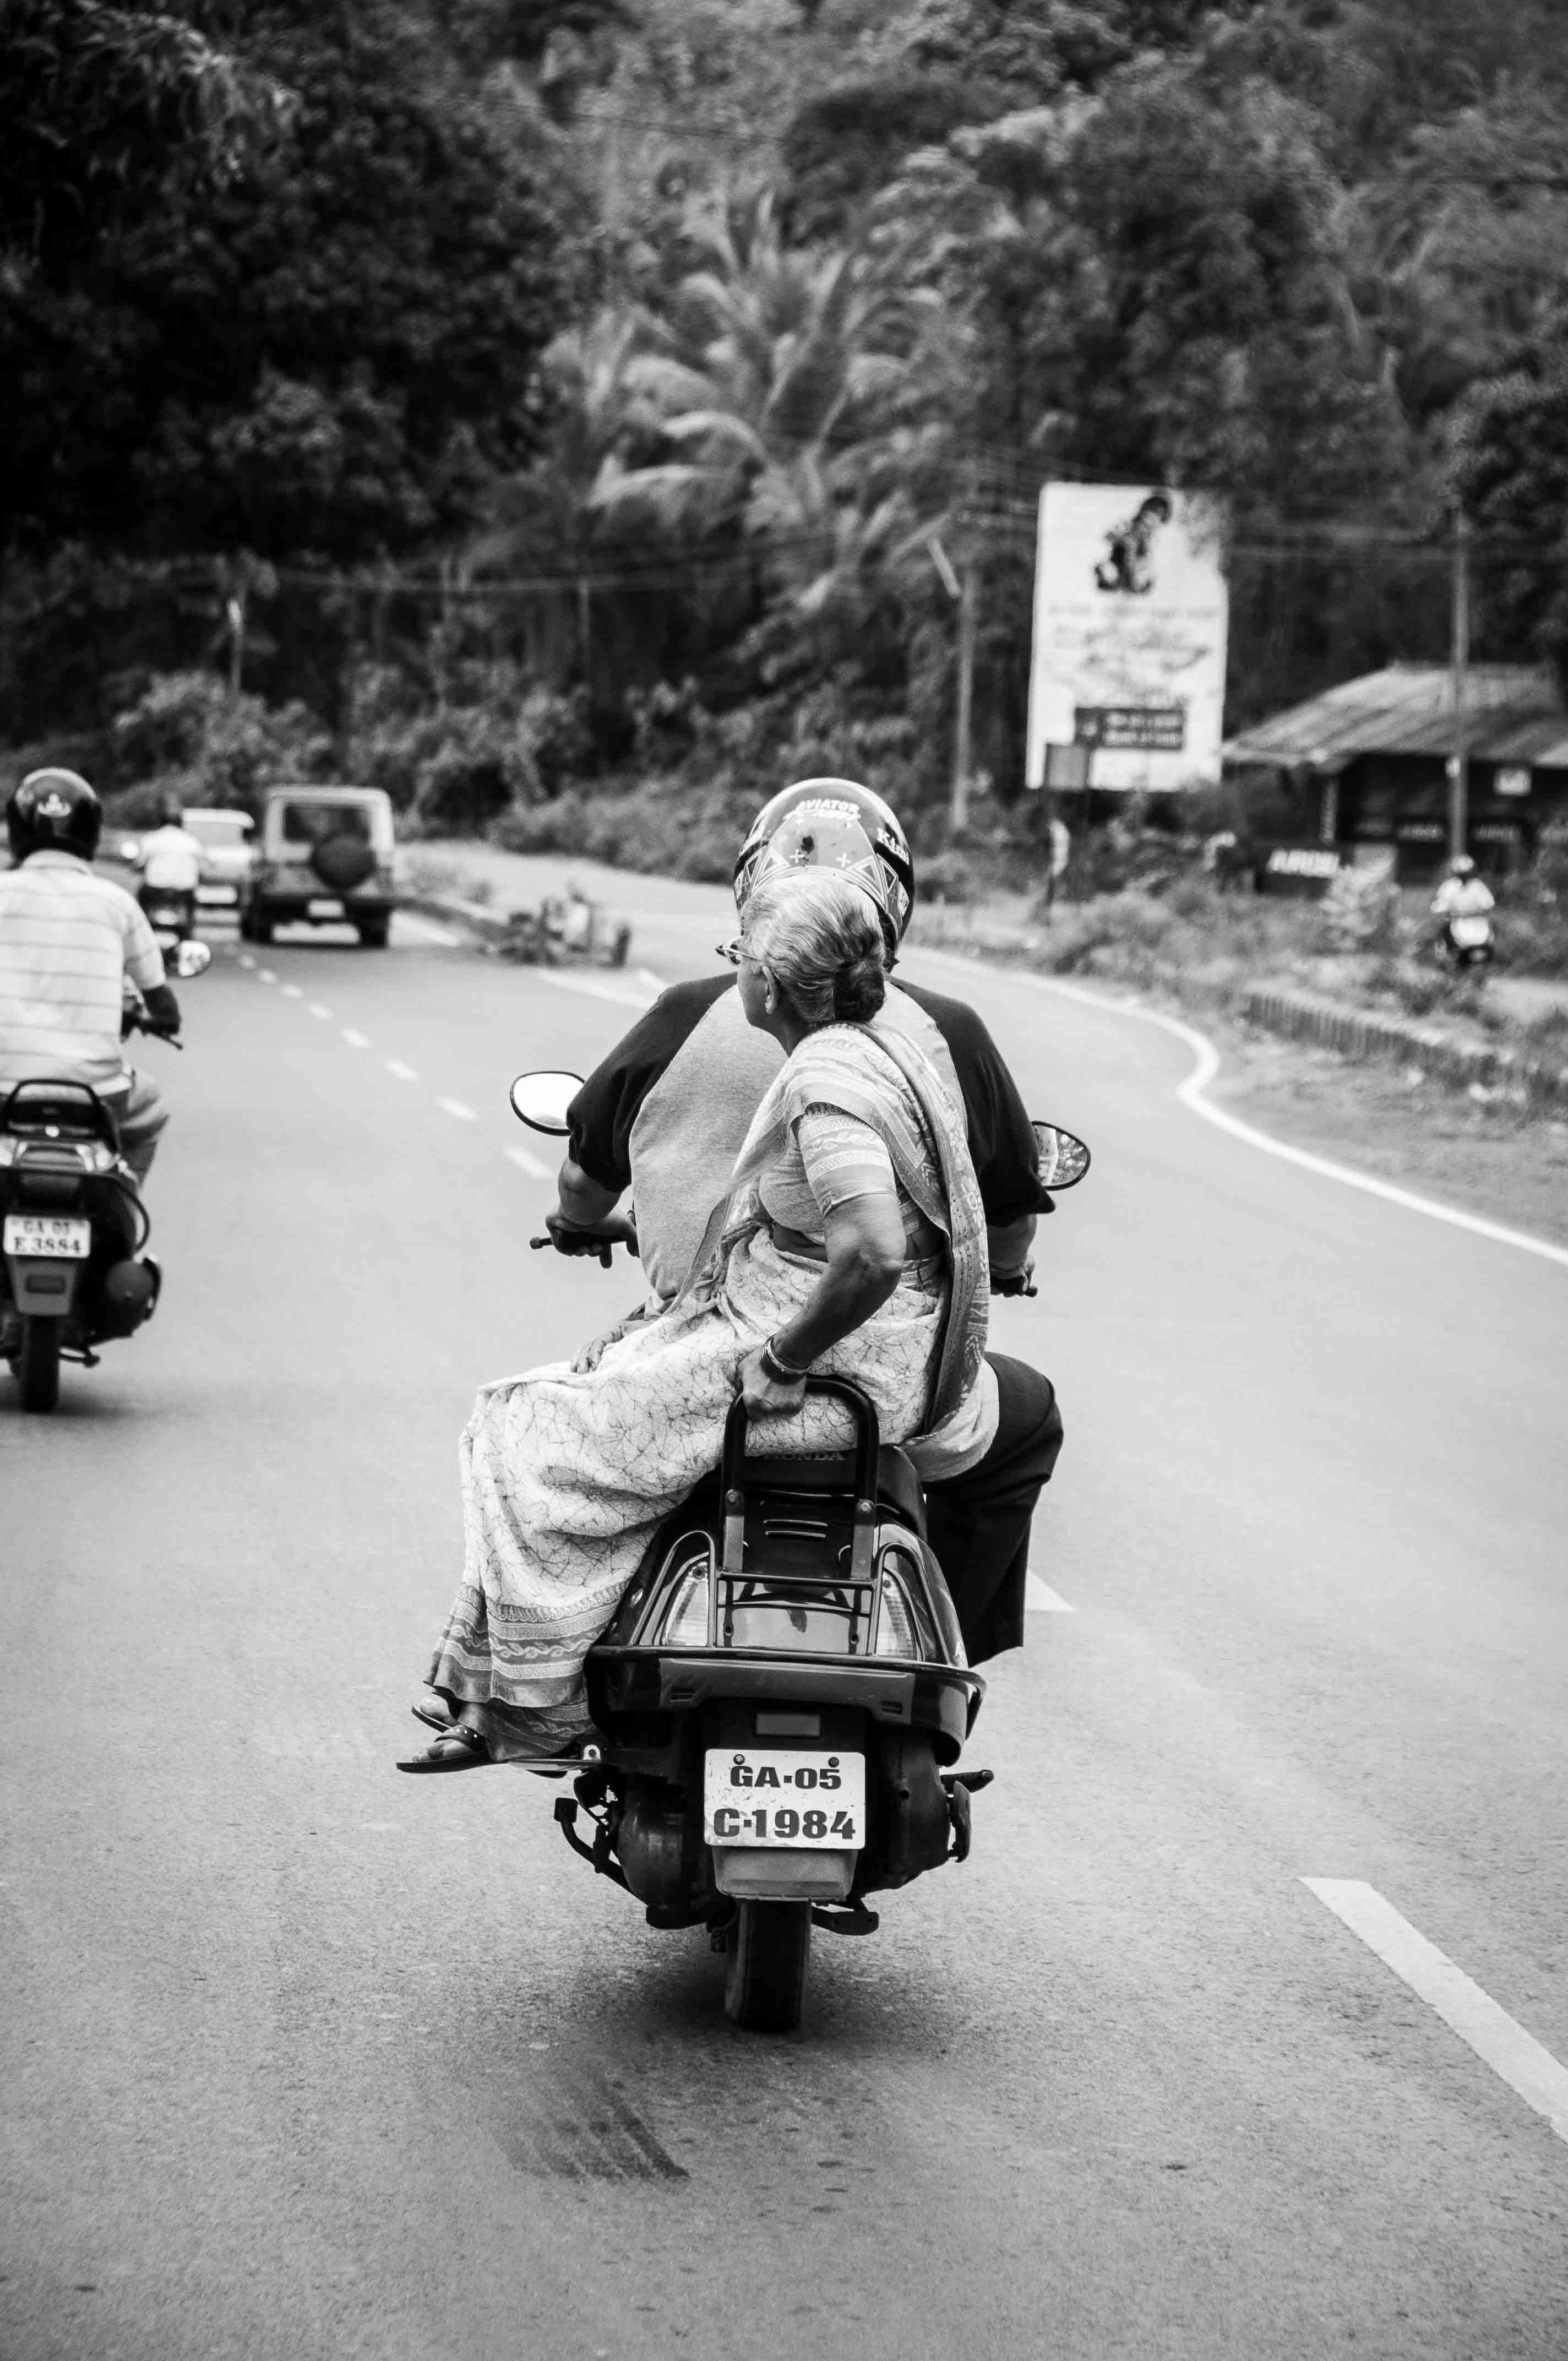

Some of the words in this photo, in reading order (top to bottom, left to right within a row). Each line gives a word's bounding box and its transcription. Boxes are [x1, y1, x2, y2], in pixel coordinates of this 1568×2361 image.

[796, 799, 859, 814] AVIATOR
[763, 1451, 846, 1461] HONDA
[730, 1765, 842, 1790] GA-05
